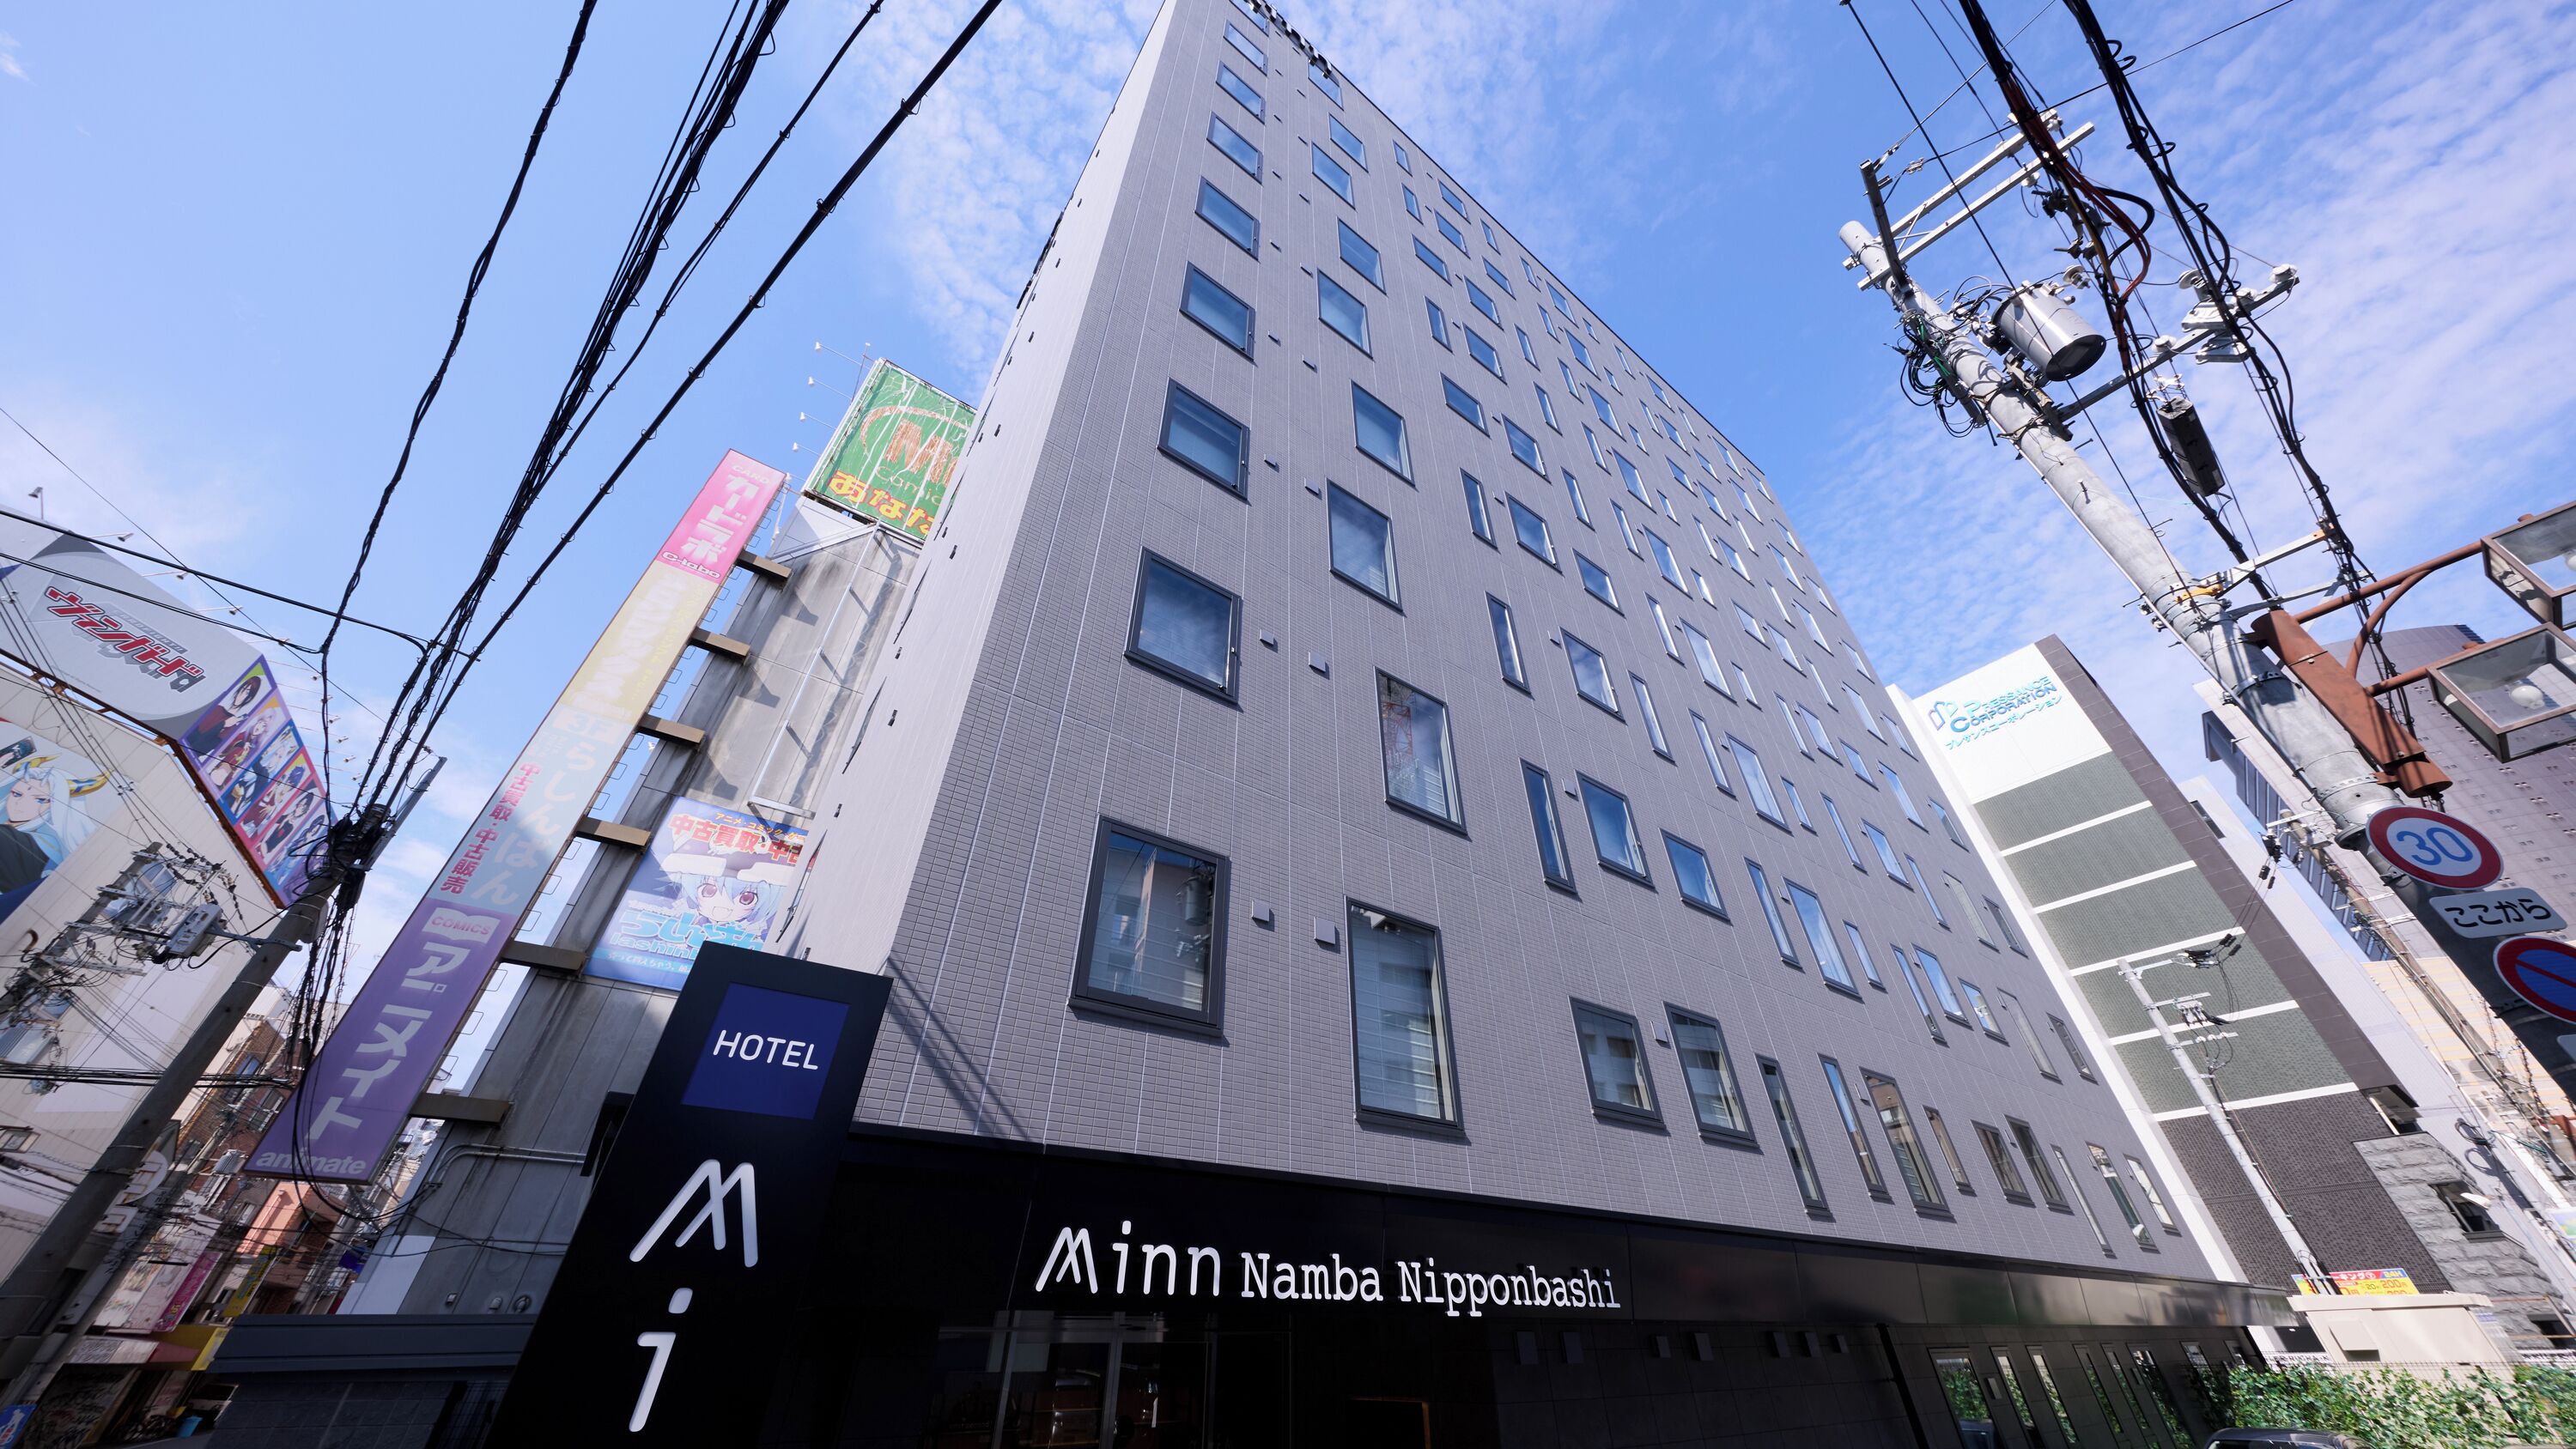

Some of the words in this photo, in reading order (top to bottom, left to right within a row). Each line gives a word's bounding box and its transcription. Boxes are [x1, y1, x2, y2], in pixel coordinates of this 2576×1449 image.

[732, 464, 770, 484] CARD
[681, 473, 760, 565] カードラボ
[662, 550, 721, 579] C-labo
[1949, 683, 2057, 733] CORPORATION
[440, 762, 543, 894] 中古買取・中古販売
[470, 740, 598, 906] らしんばん
[2396, 827, 2474, 866] 30
[431, 915, 492, 937] COMICS
[2445, 898, 2552, 927] ここから
[304, 941, 471, 1141] アニメイト
[713, 1030, 819, 1071] HOTEL
[255, 1148, 367, 1175] animate
[1035, 1220, 1221, 1297] Minn
[1241, 1252, 1385, 1302] Namba
[1397, 1257, 1622, 1318] Nipponbashi
